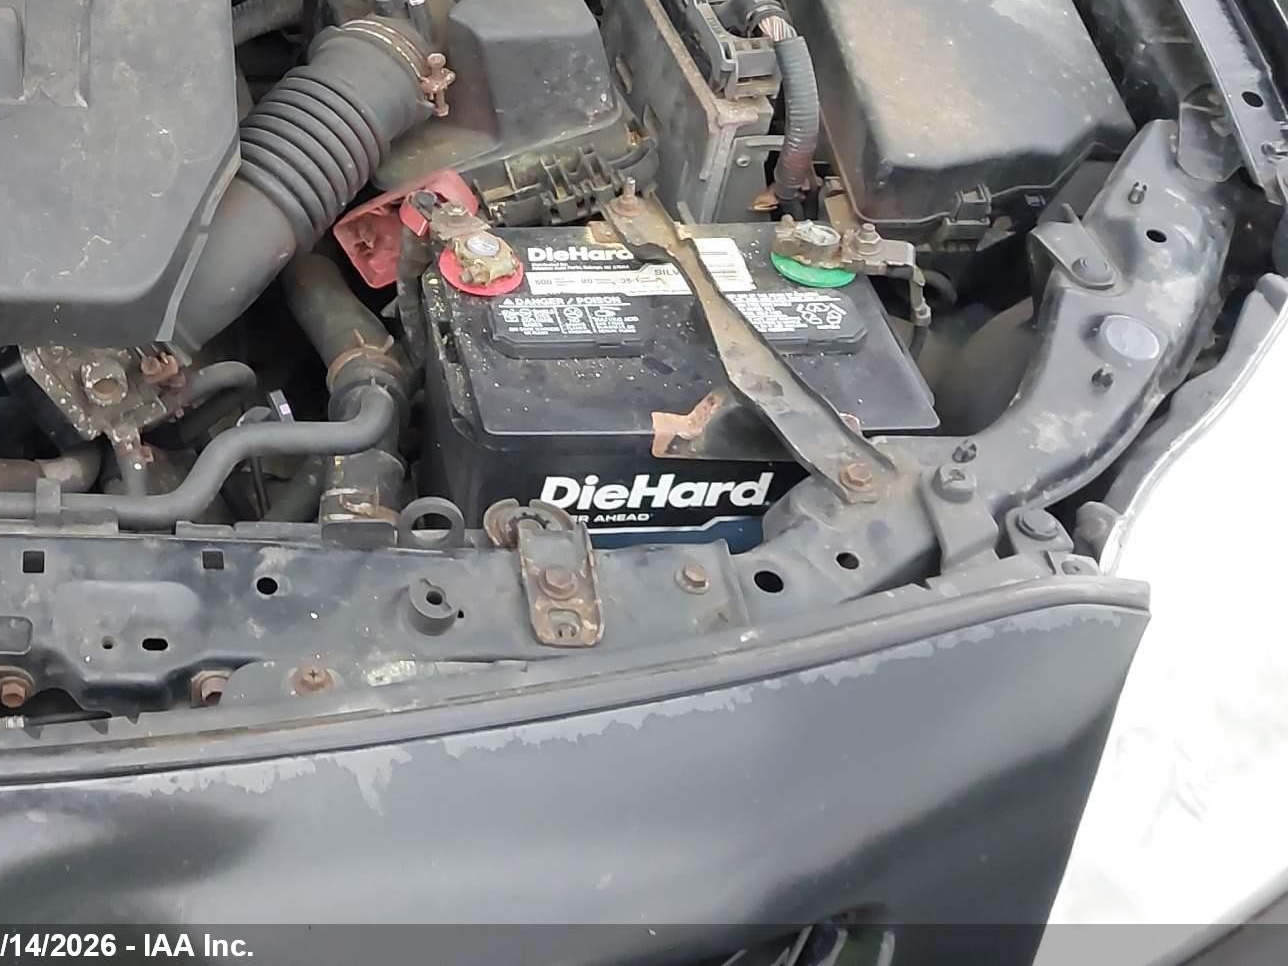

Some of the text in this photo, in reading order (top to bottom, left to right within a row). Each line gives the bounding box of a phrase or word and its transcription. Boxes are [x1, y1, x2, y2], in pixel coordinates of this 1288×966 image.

[514, 297, 565, 306] DANGER
[575, 296, 622, 305] POISON
[540, 472, 774, 510] DieHard
[593, 513, 650, 523] AHEAD
